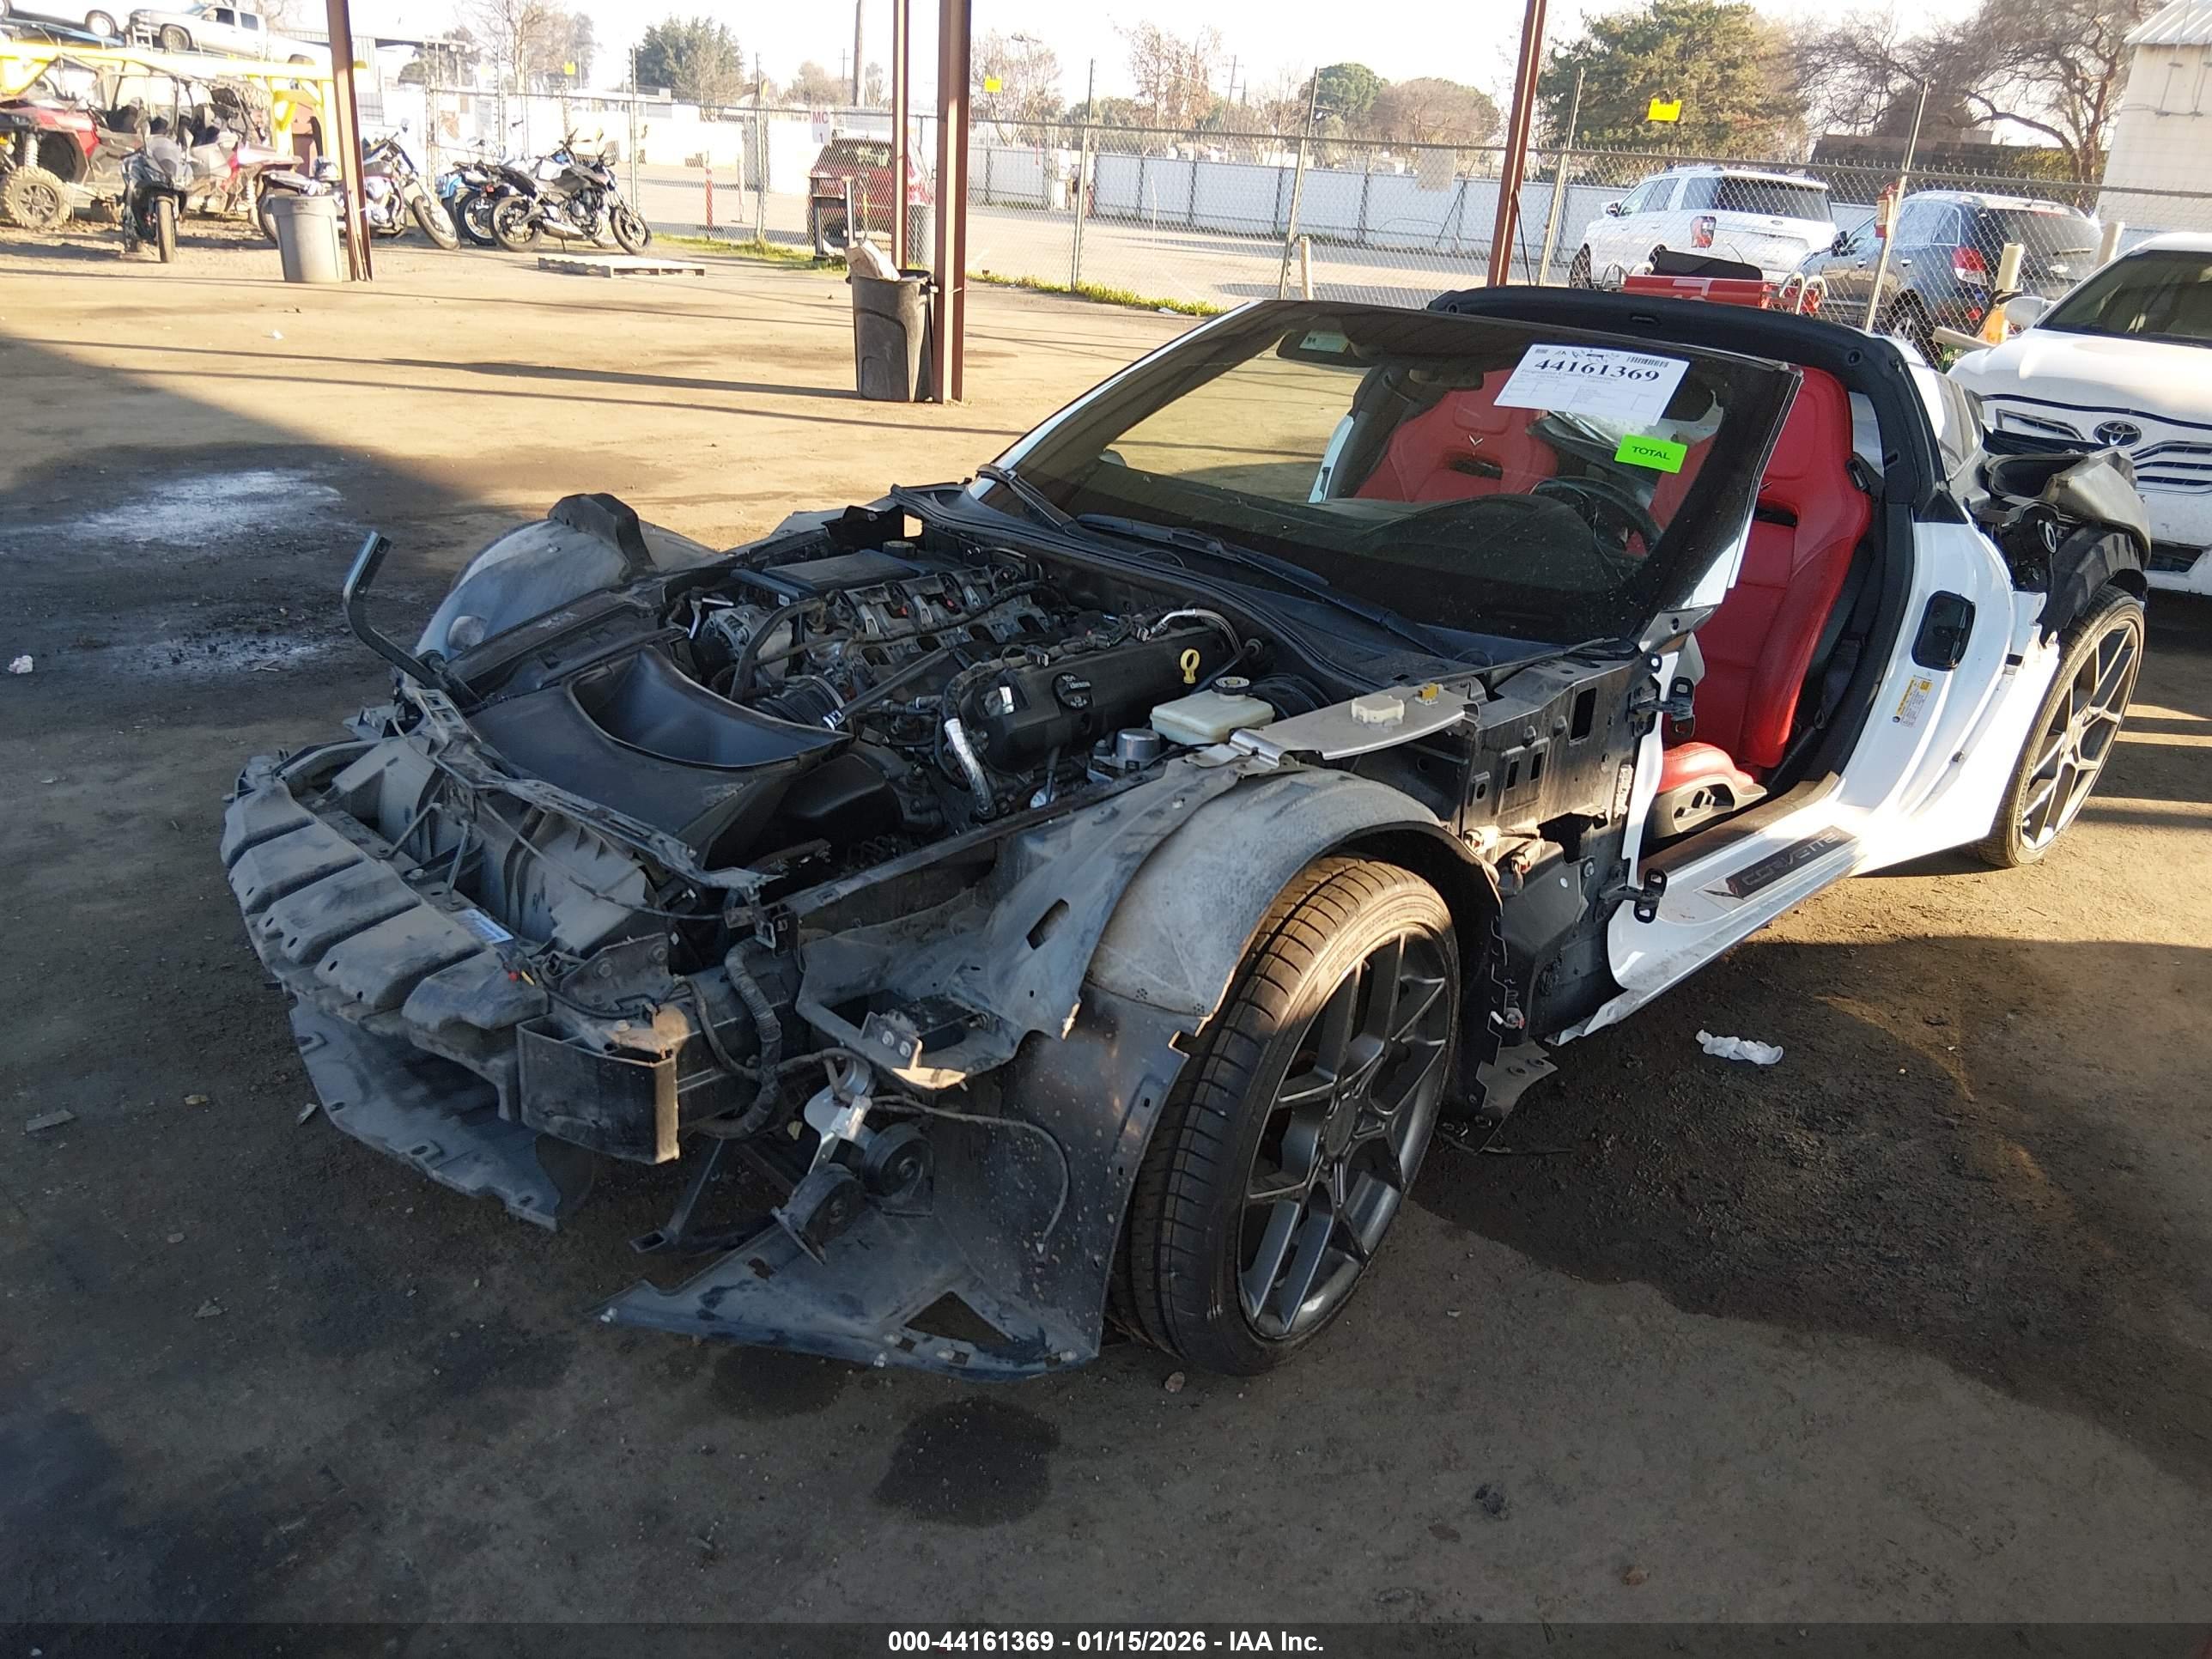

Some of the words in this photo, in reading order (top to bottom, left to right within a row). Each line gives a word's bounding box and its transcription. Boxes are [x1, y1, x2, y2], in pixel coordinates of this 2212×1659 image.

[812, 112, 829, 124] MC
[1534, 359, 1660, 382] 44161369
[1632, 447, 1670, 459] TOTAL
